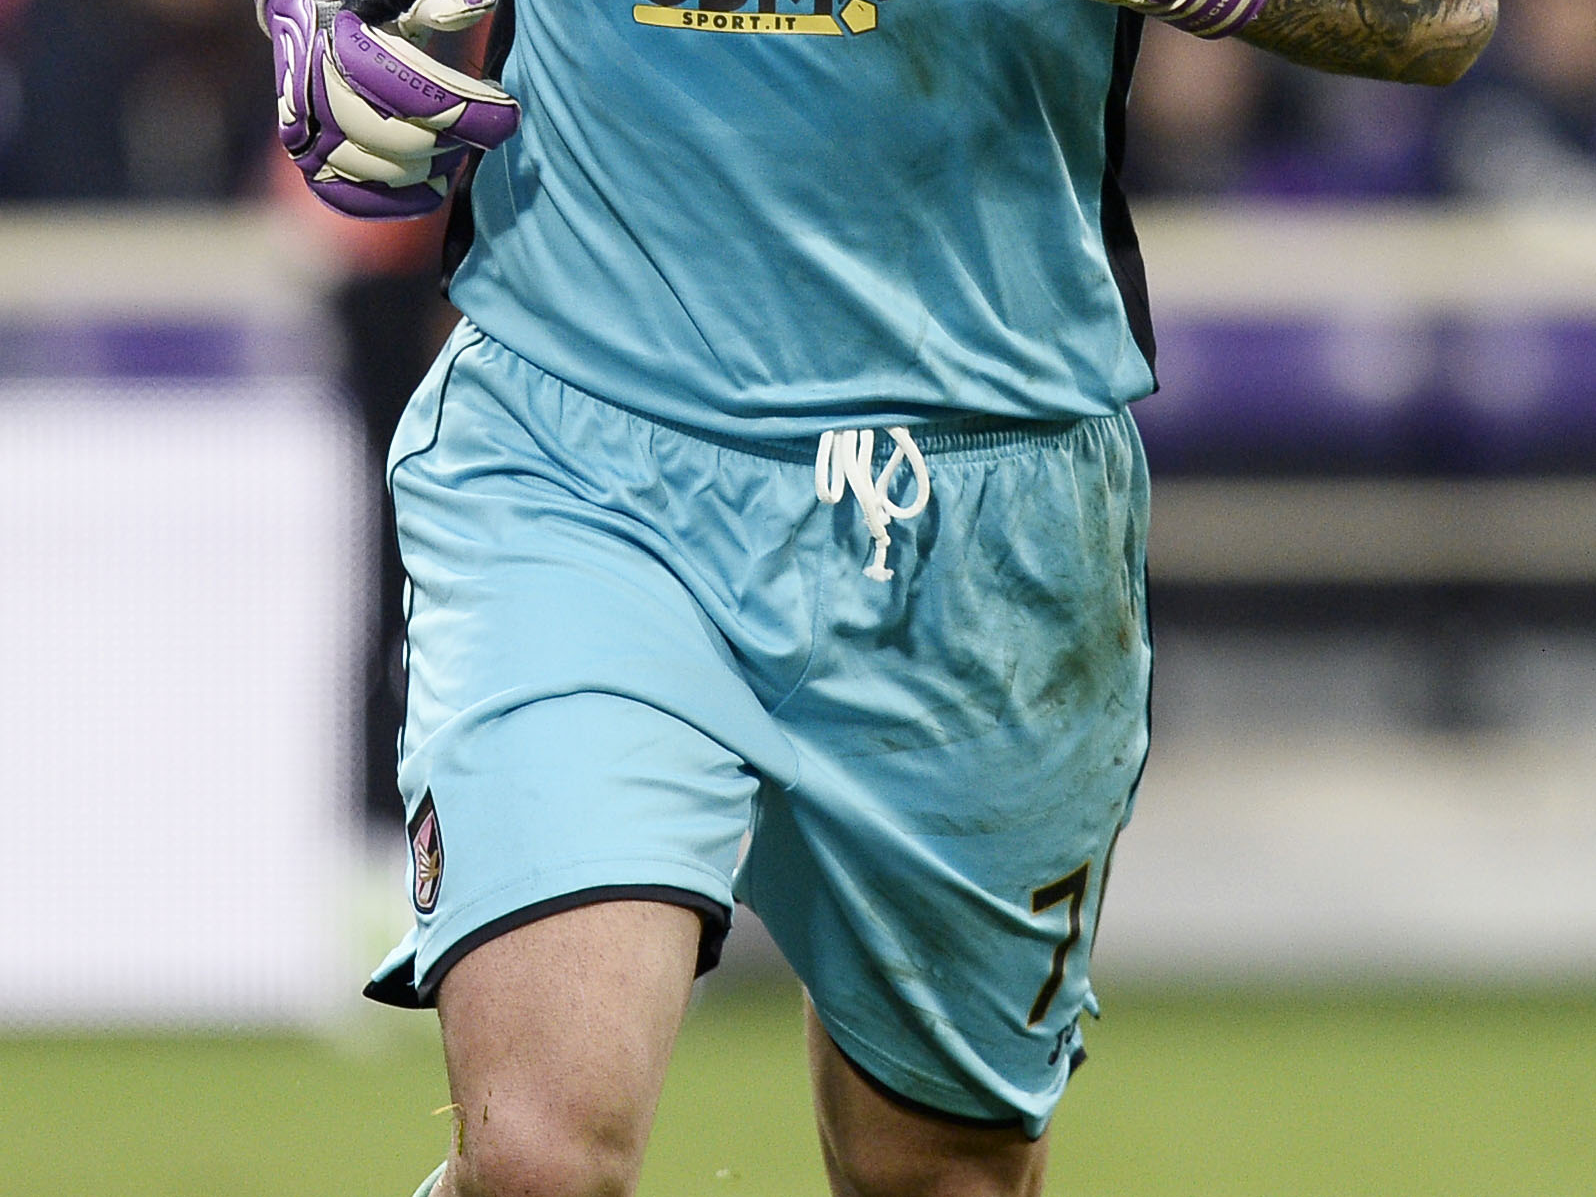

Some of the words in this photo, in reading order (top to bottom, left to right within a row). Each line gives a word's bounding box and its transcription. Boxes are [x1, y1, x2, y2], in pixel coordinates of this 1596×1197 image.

[681, 11, 797, 31] SPORT.IT
[350, 32, 372, 53] HO
[374, 52, 447, 104] SOCCER
[1026, 838, 1112, 1030] 7
